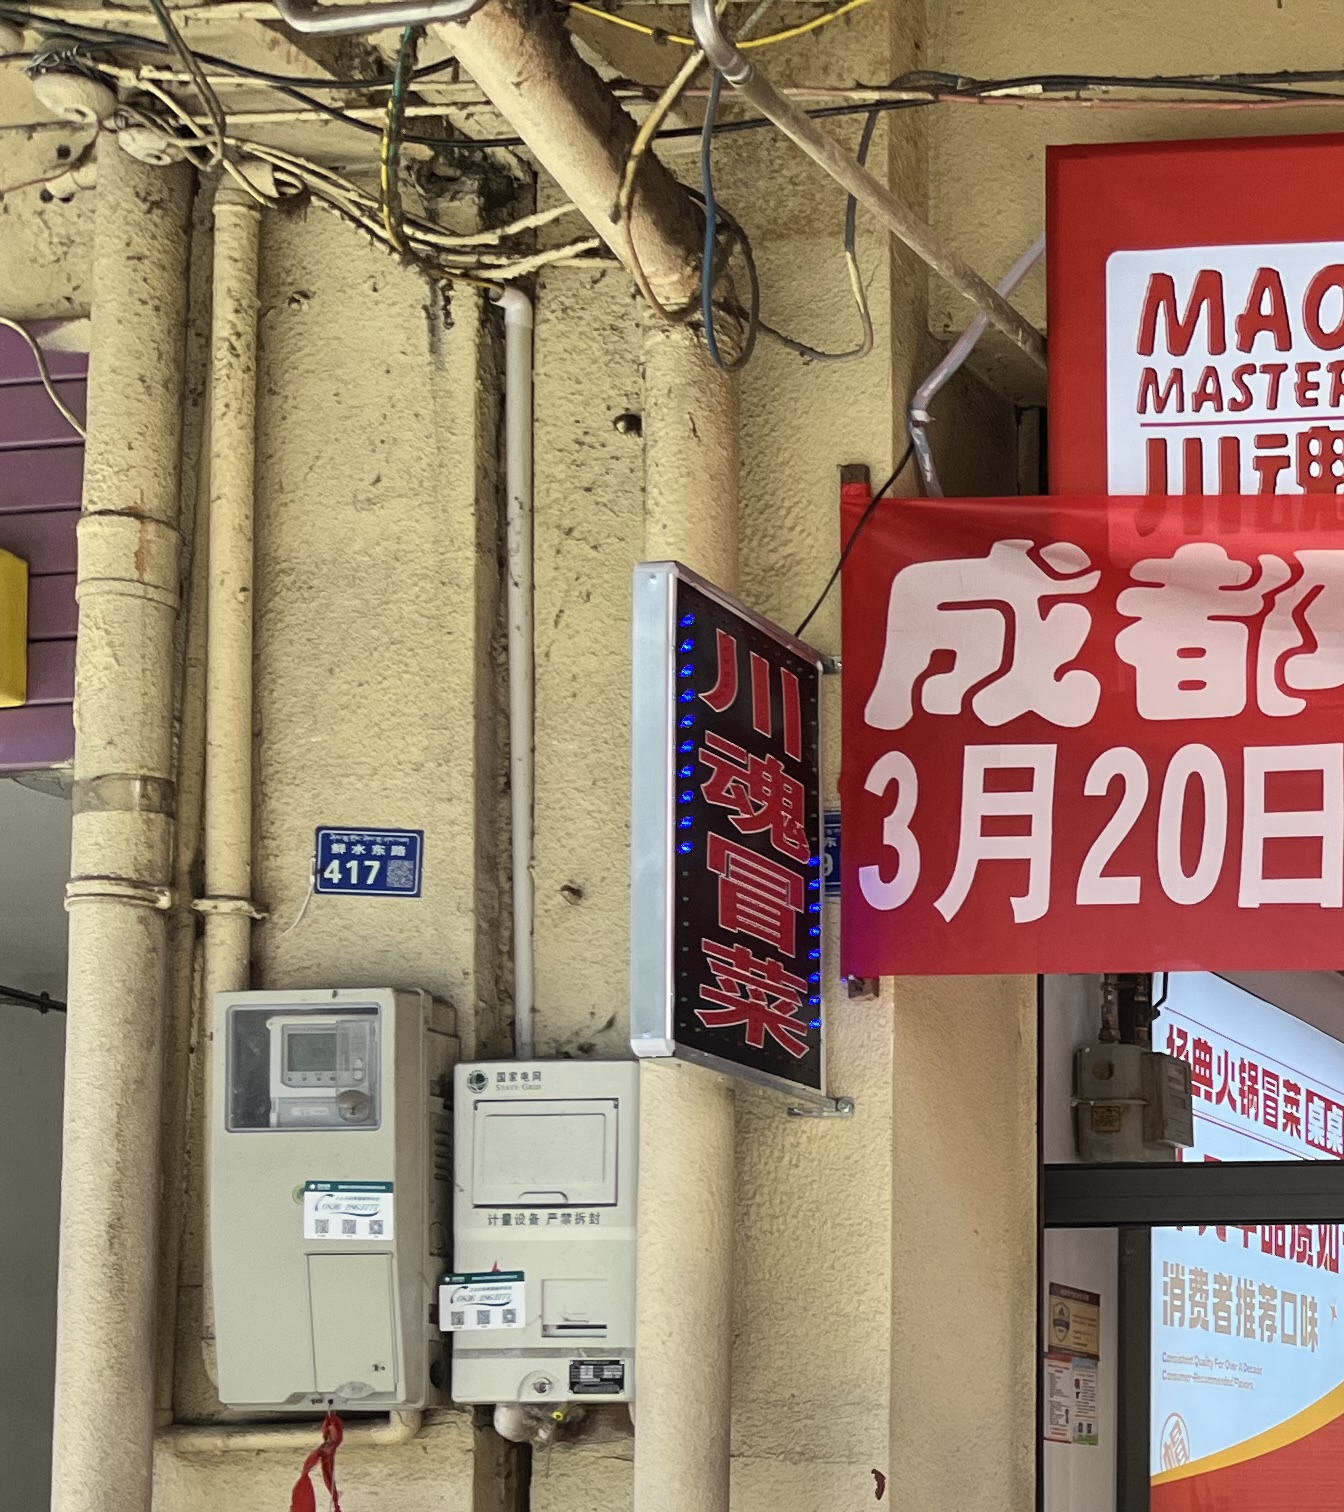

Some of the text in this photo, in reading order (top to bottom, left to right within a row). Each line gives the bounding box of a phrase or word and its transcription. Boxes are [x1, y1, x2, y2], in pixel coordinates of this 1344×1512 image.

[695, 628, 811, 1059] 川魂冒菜
[324, 860, 380, 884] 417
[497, 1071, 542, 1082] 国家电网
[487, 1212, 601, 1226] 计量设备 严禁拆封
[1162, 1261, 1318, 1352] 消费者推荐口味
